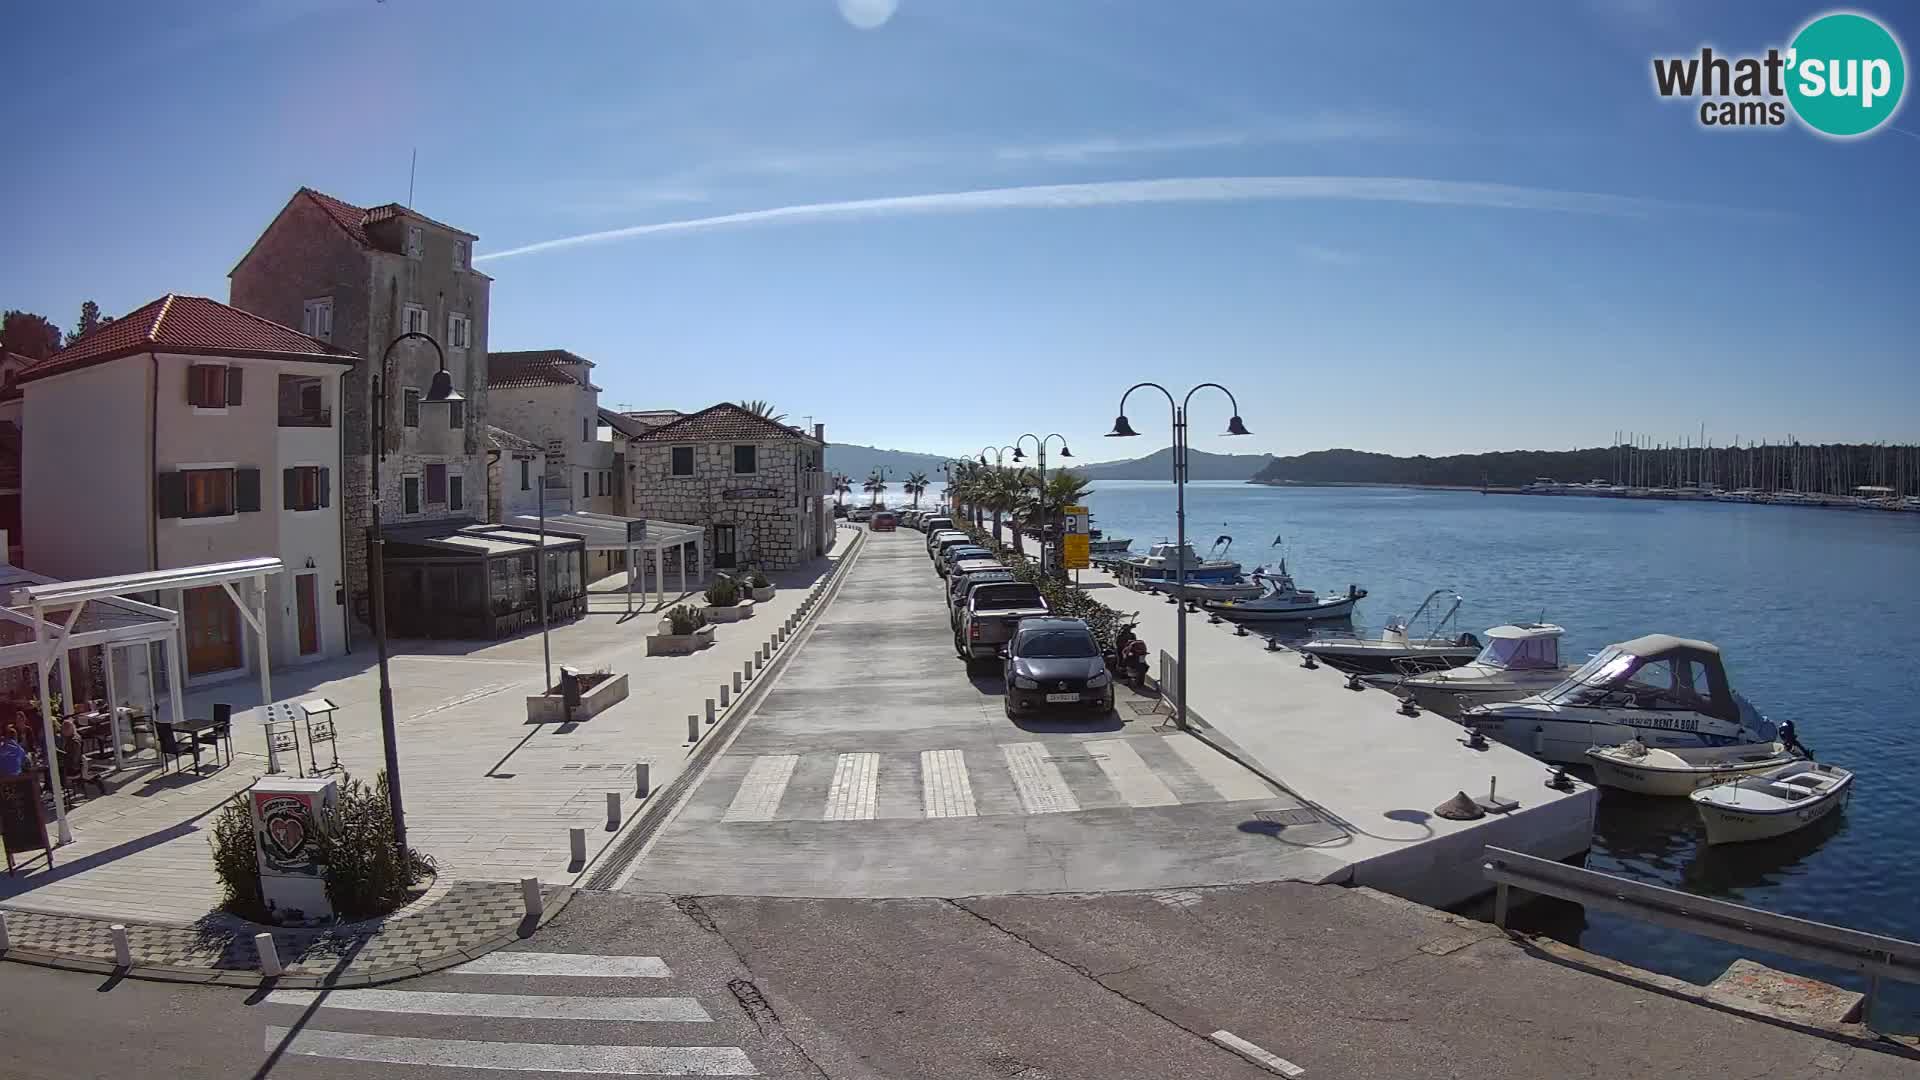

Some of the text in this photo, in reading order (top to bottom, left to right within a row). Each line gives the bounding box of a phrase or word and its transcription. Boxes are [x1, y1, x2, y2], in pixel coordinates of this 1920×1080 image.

[1066, 516, 1076, 532] P
[1653, 718, 1673, 729] RENT
[1674, 719, 1680, 729] A
[1680, 719, 1700, 731] BOAT
